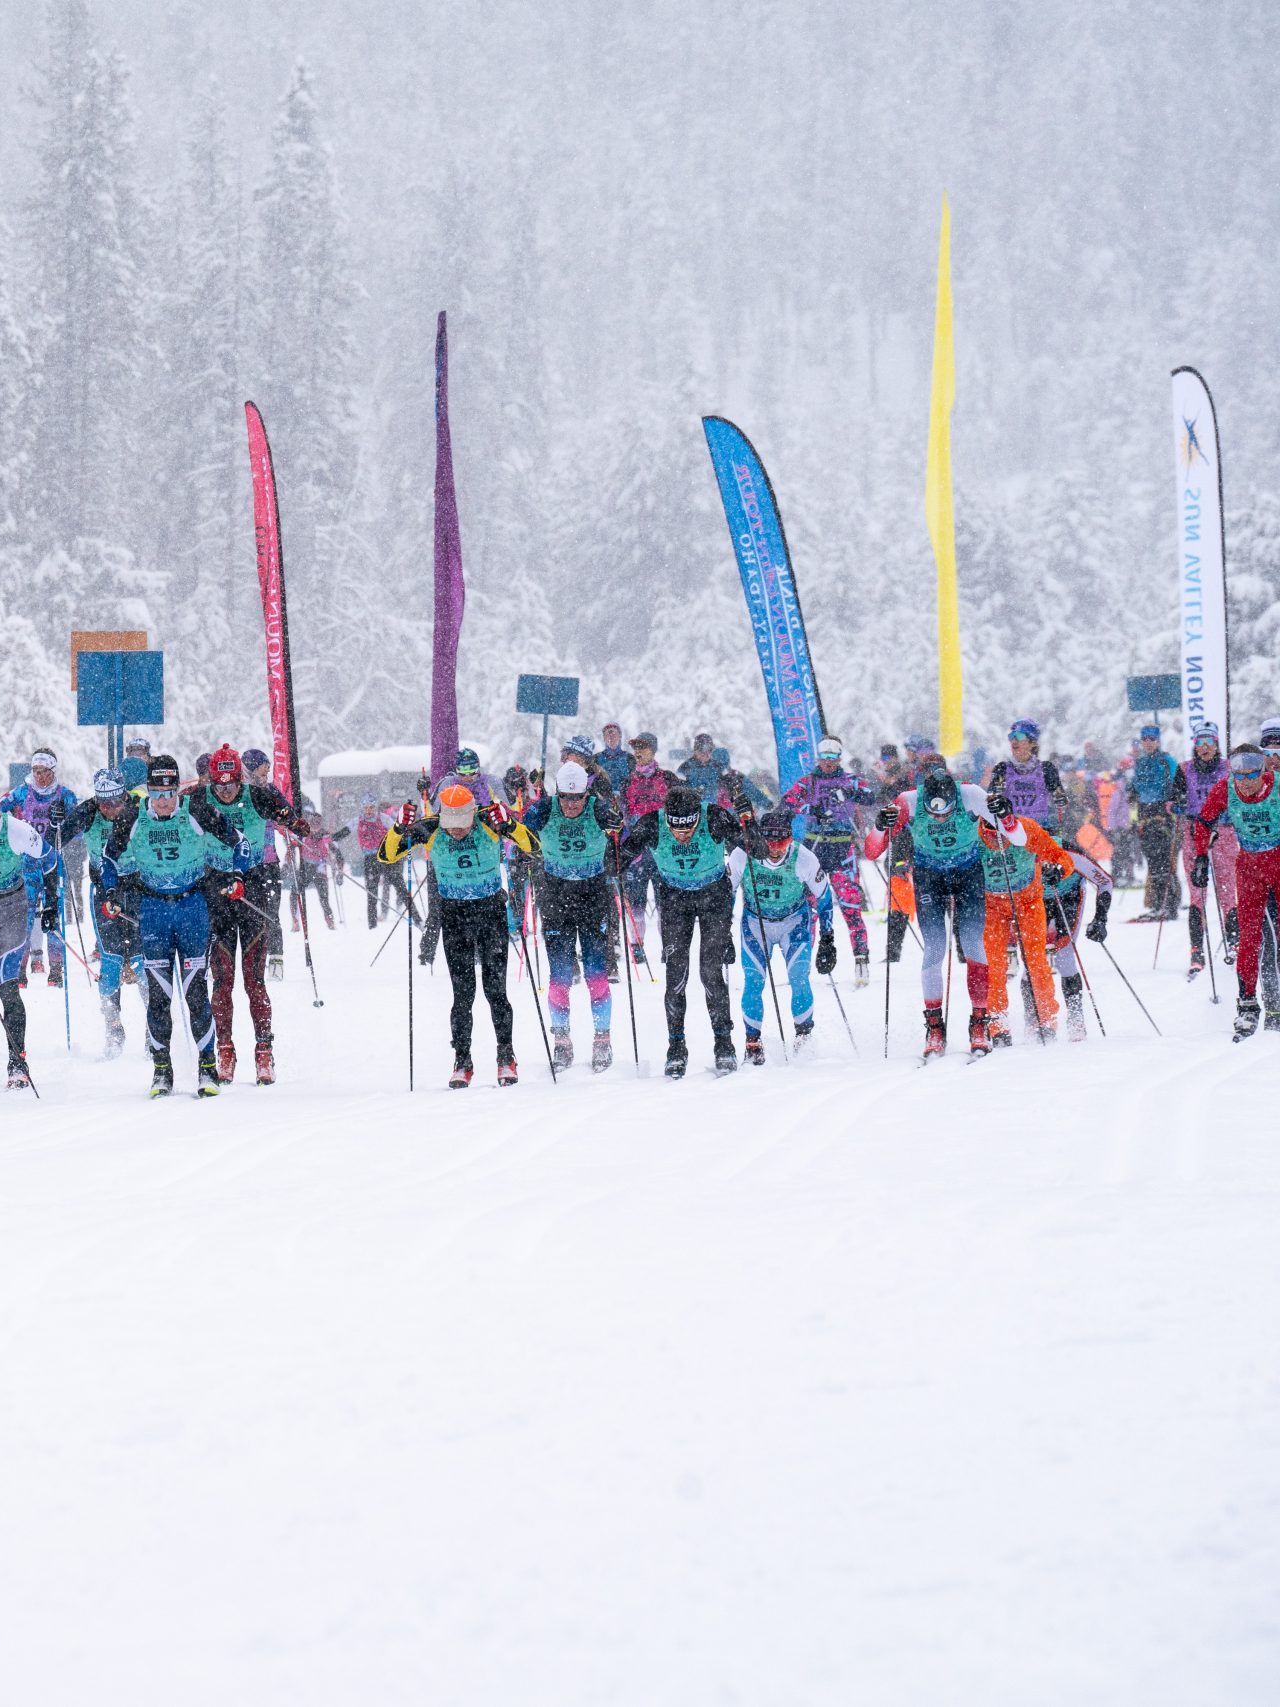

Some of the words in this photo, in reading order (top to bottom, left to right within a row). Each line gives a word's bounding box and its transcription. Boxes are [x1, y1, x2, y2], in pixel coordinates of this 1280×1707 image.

[149, 830, 179, 839] BOULDER
[1248, 825, 1270, 834] 21
[559, 840, 586, 852] 39
[931, 836, 957, 848] 19
[152, 847, 179, 860] 13
[675, 859, 699, 870] 17
[757, 889, 780, 899] 41
